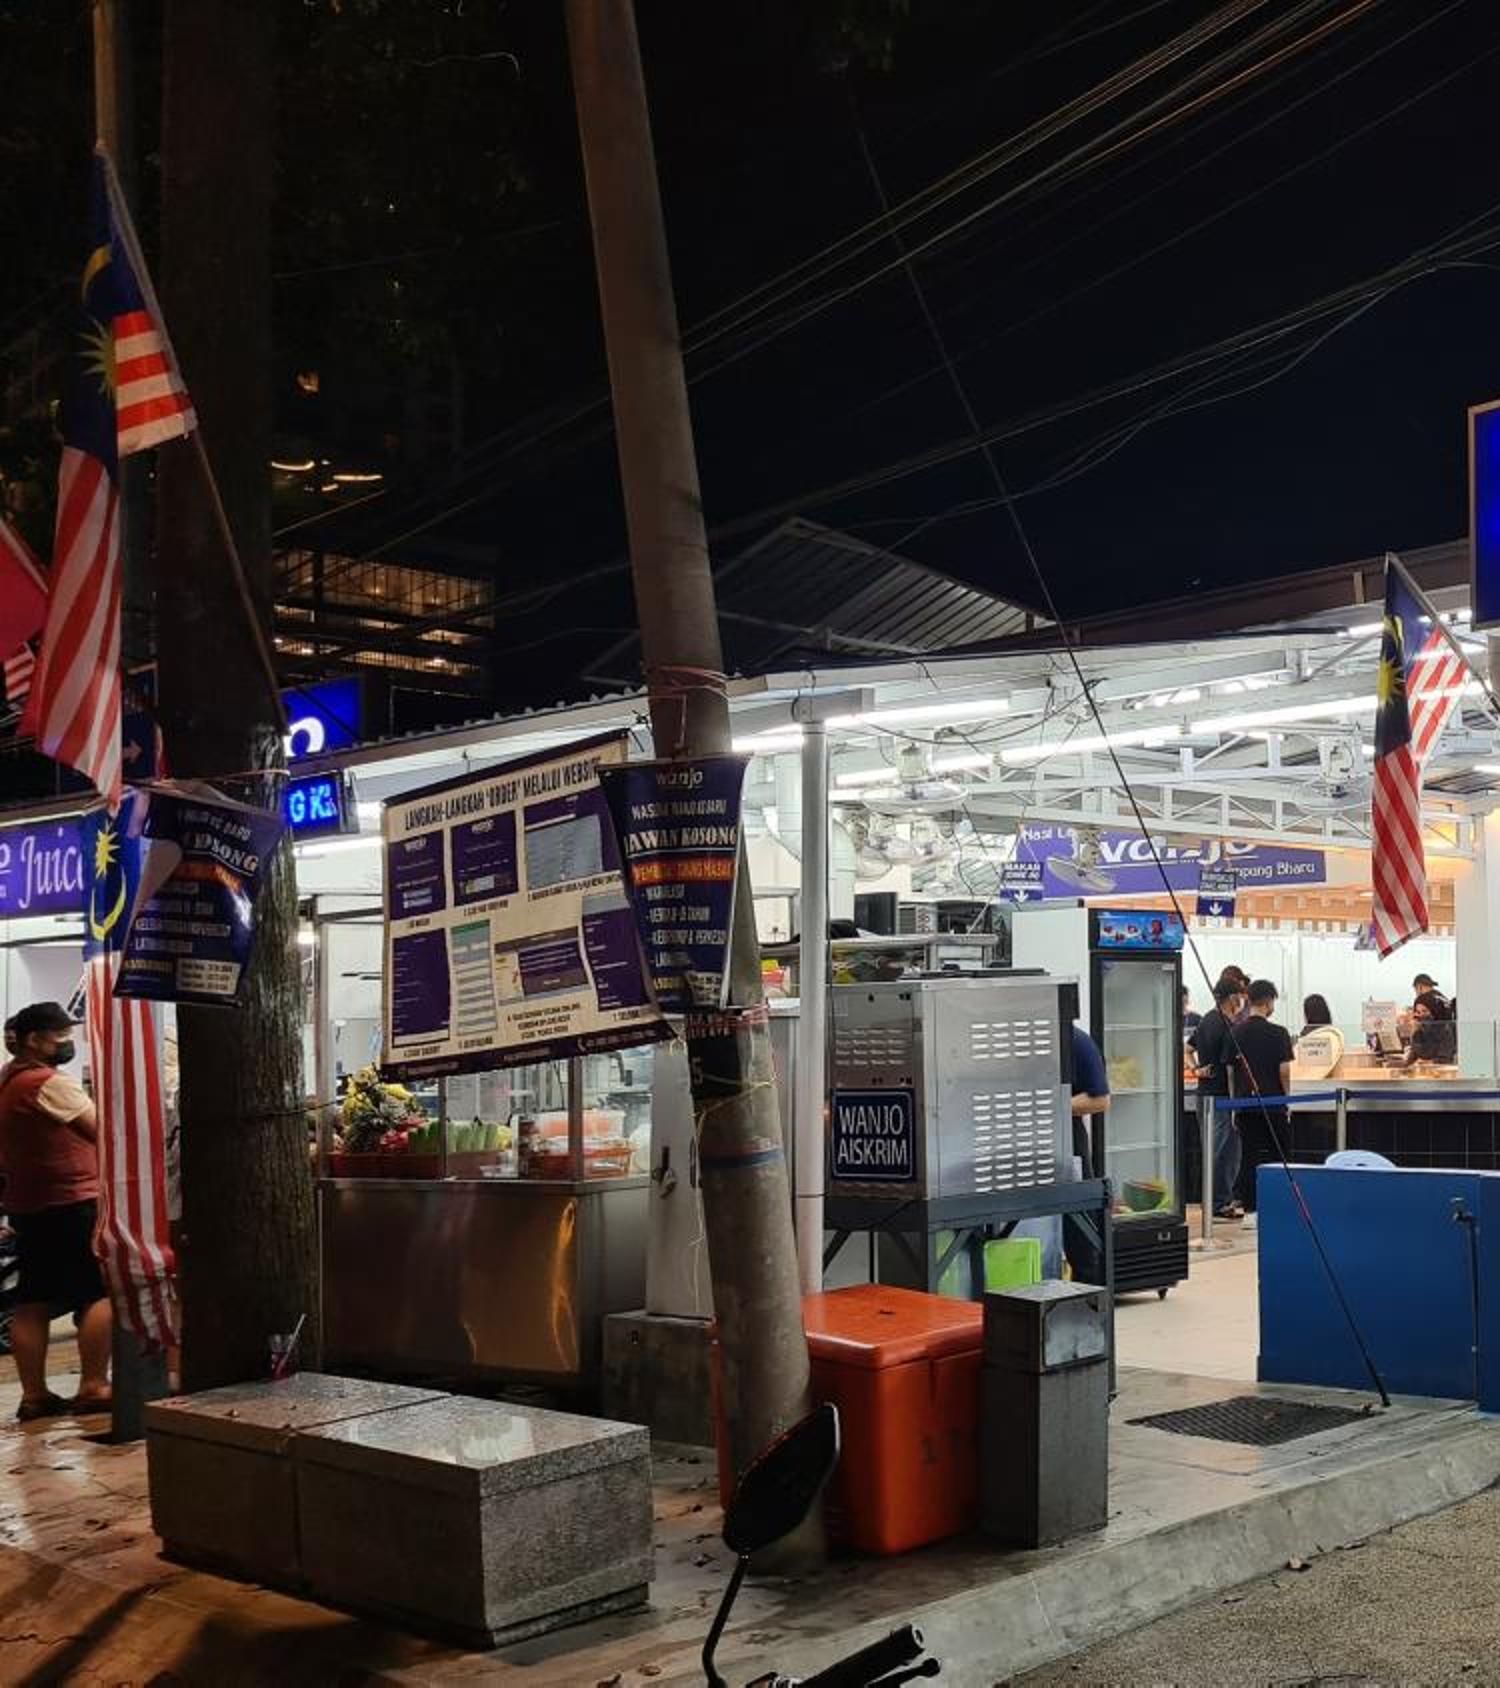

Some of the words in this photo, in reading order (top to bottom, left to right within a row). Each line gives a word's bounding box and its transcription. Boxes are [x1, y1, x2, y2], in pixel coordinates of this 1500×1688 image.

[563, 757, 601, 787] WEBSIT
[1276, 861, 1316, 876] Bharu
[838, 1103, 904, 1136] WANJO
[837, 1137, 908, 1167] AISKRIM
